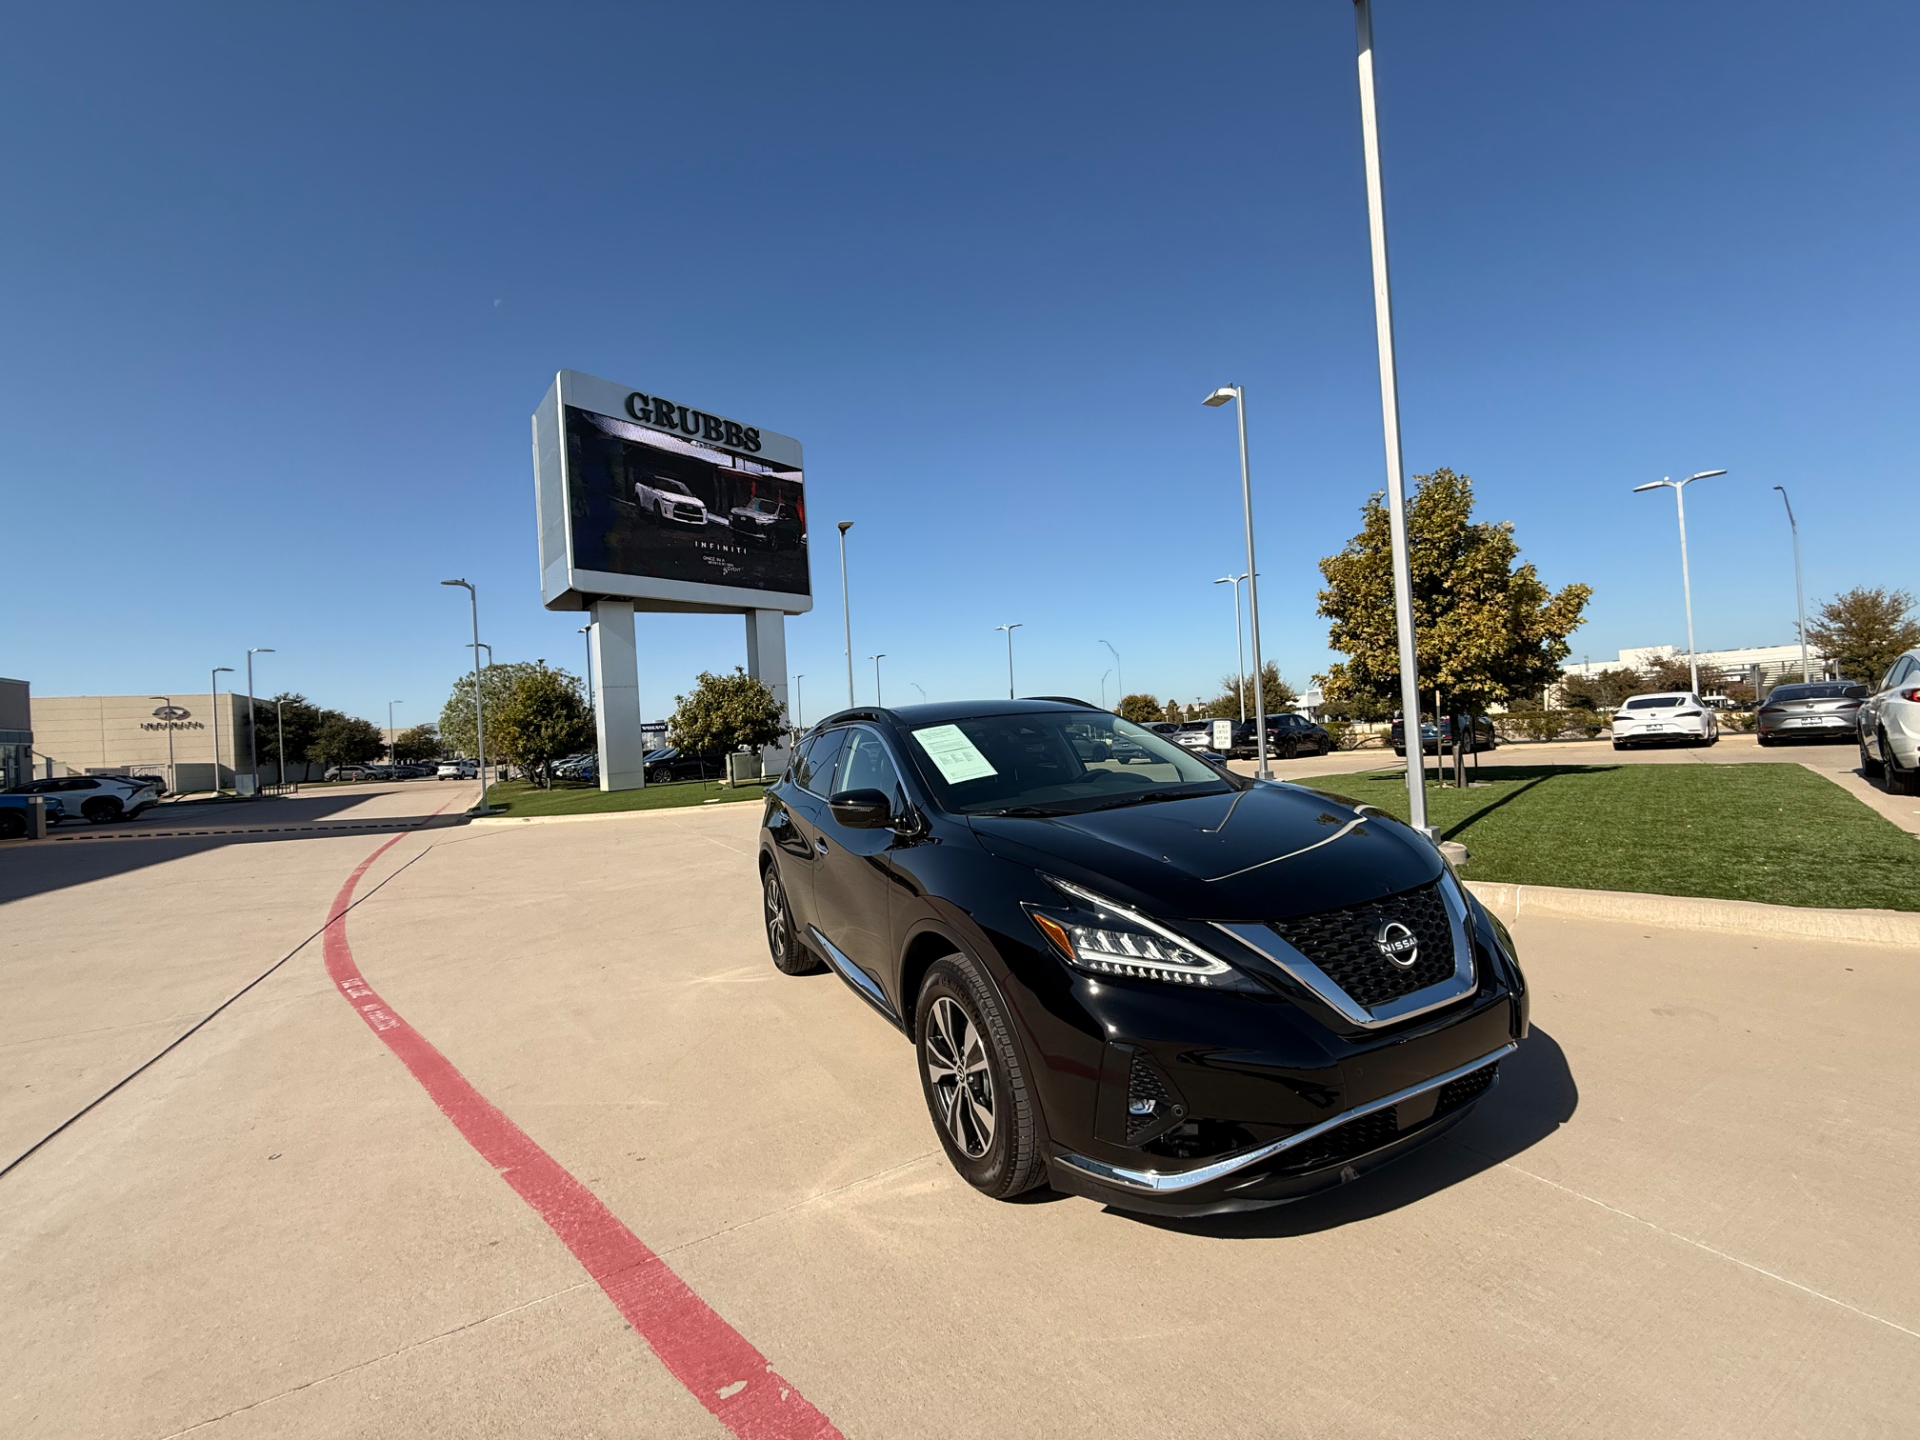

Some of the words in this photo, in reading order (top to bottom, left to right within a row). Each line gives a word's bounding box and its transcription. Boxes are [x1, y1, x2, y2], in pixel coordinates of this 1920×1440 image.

[625, 391, 762, 452] GRUBBS
[694, 540, 747, 555] INFINITI
[1379, 936, 1418, 953] NISSAN
